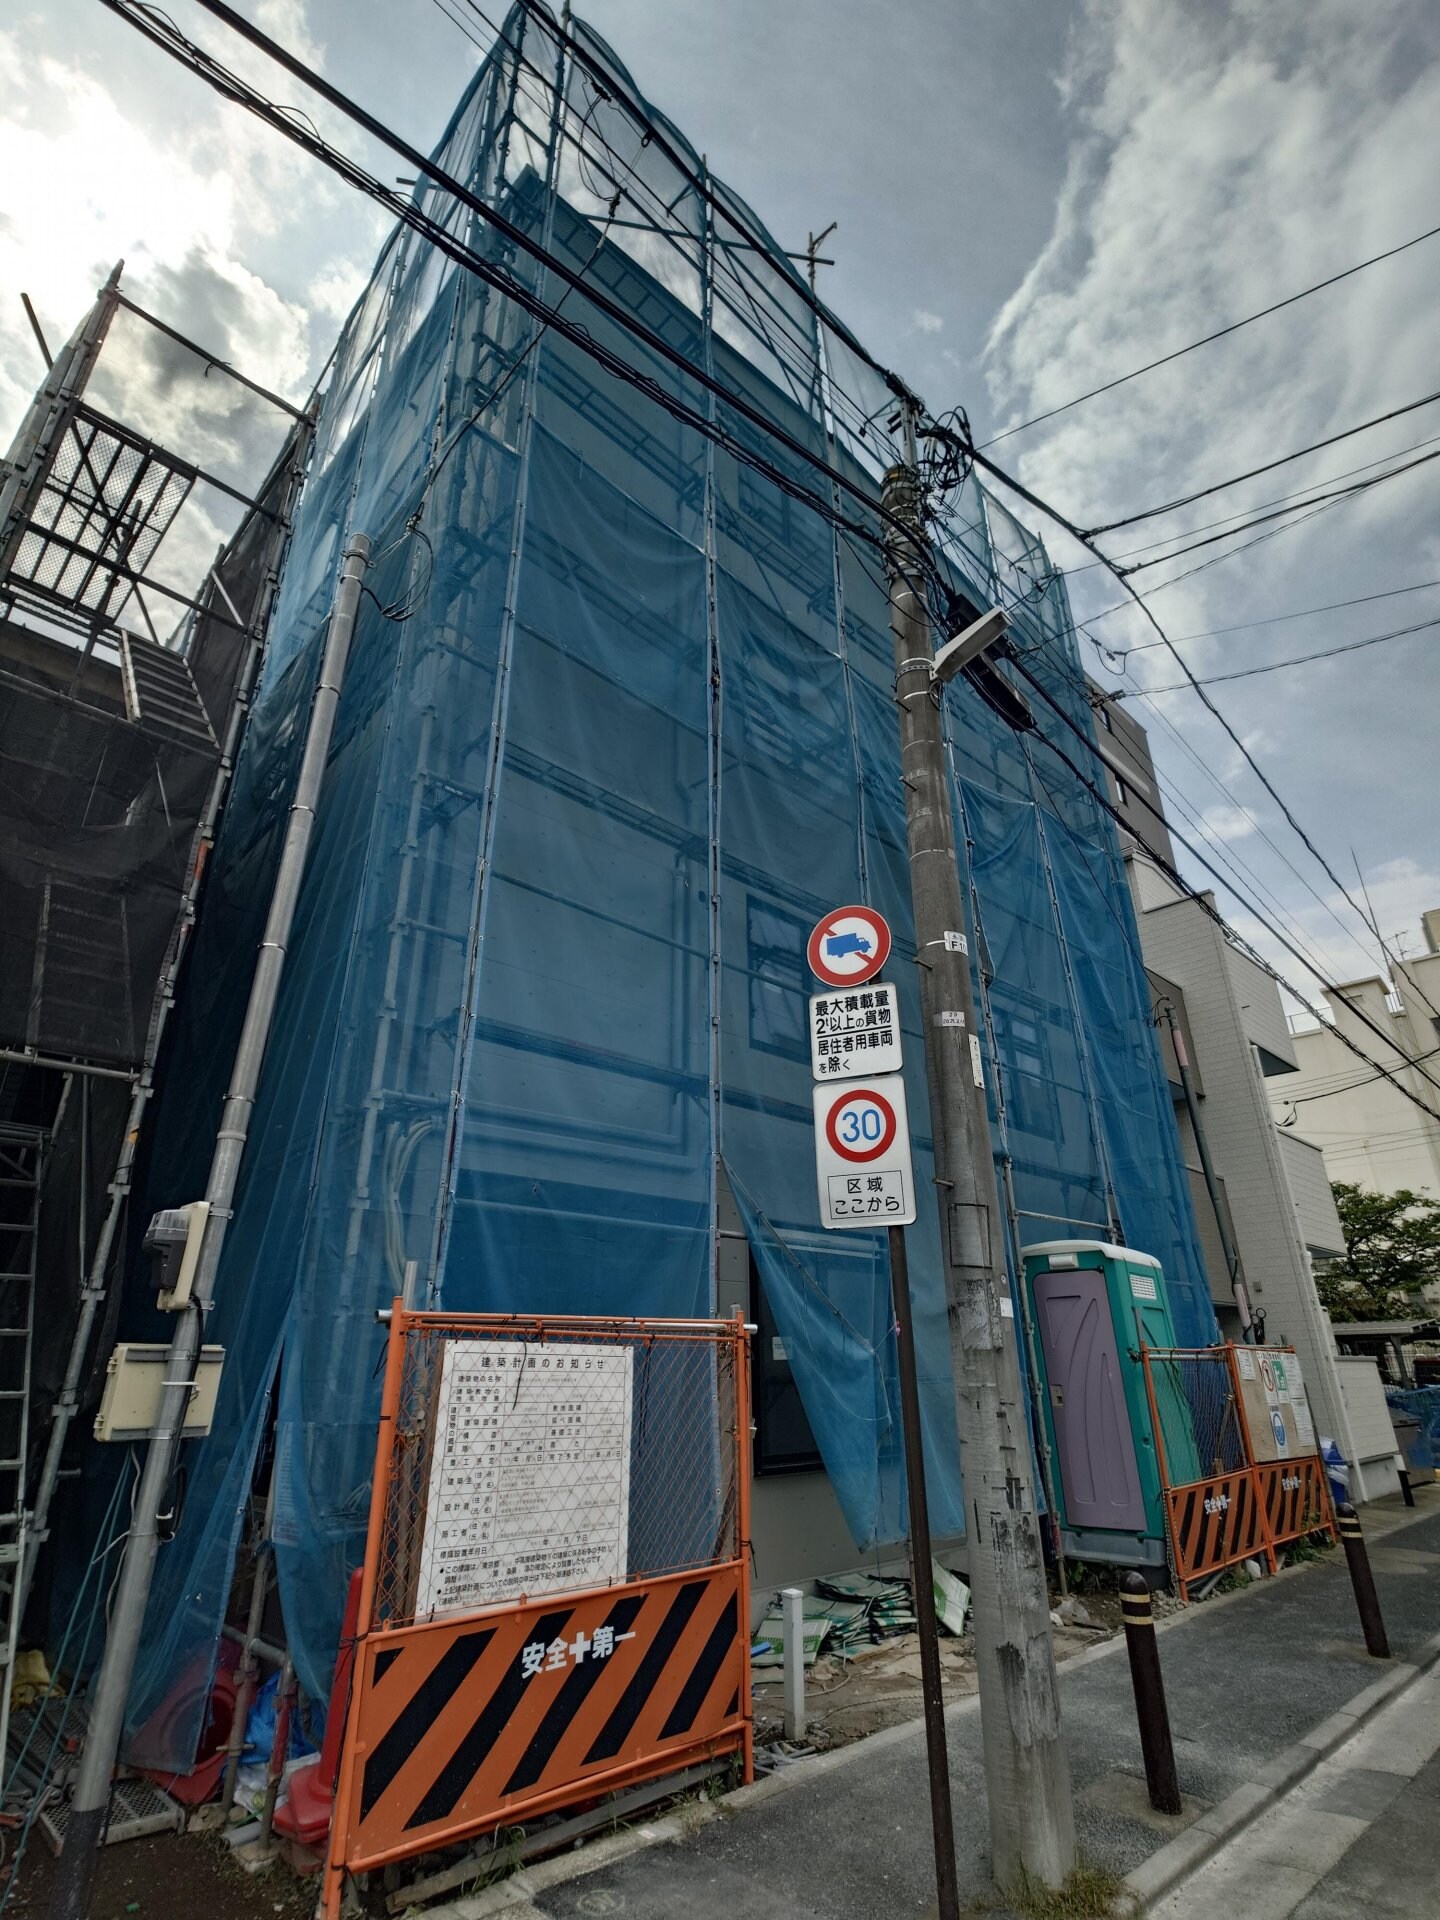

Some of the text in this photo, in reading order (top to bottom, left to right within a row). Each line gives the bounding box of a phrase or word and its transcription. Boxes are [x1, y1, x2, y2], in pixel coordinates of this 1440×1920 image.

[815, 990, 889, 1016] 最大積載量
[816, 1008, 891, 1034] 2t以上の貨物
[818, 1029, 893, 1056] 居住者用車両
[818, 1056, 850, 1073] を除く
[842, 1109, 880, 1142] 30
[847, 1176, 883, 1194] 区域
[835, 1196, 900, 1215] ここから
[480, 1356, 604, 1369] 建築計画のお知らせ
